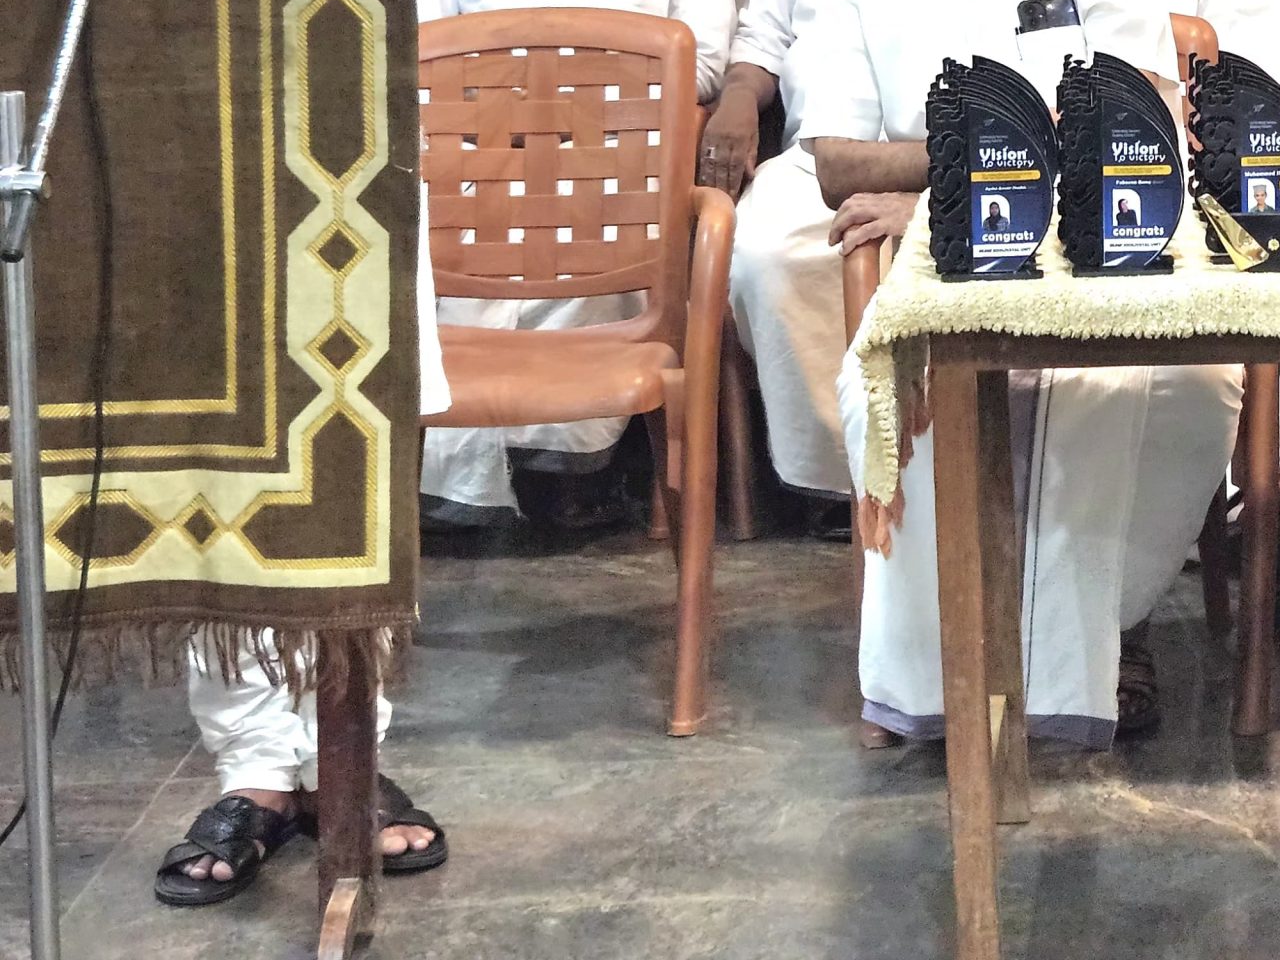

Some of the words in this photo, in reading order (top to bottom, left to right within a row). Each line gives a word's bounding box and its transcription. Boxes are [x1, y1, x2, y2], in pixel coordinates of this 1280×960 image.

[979, 147, 1027, 161] Vision
[1112, 141, 1159, 156] Vision
[982, 230, 1034, 242] congrats
[1112, 226, 1164, 237] congrats
